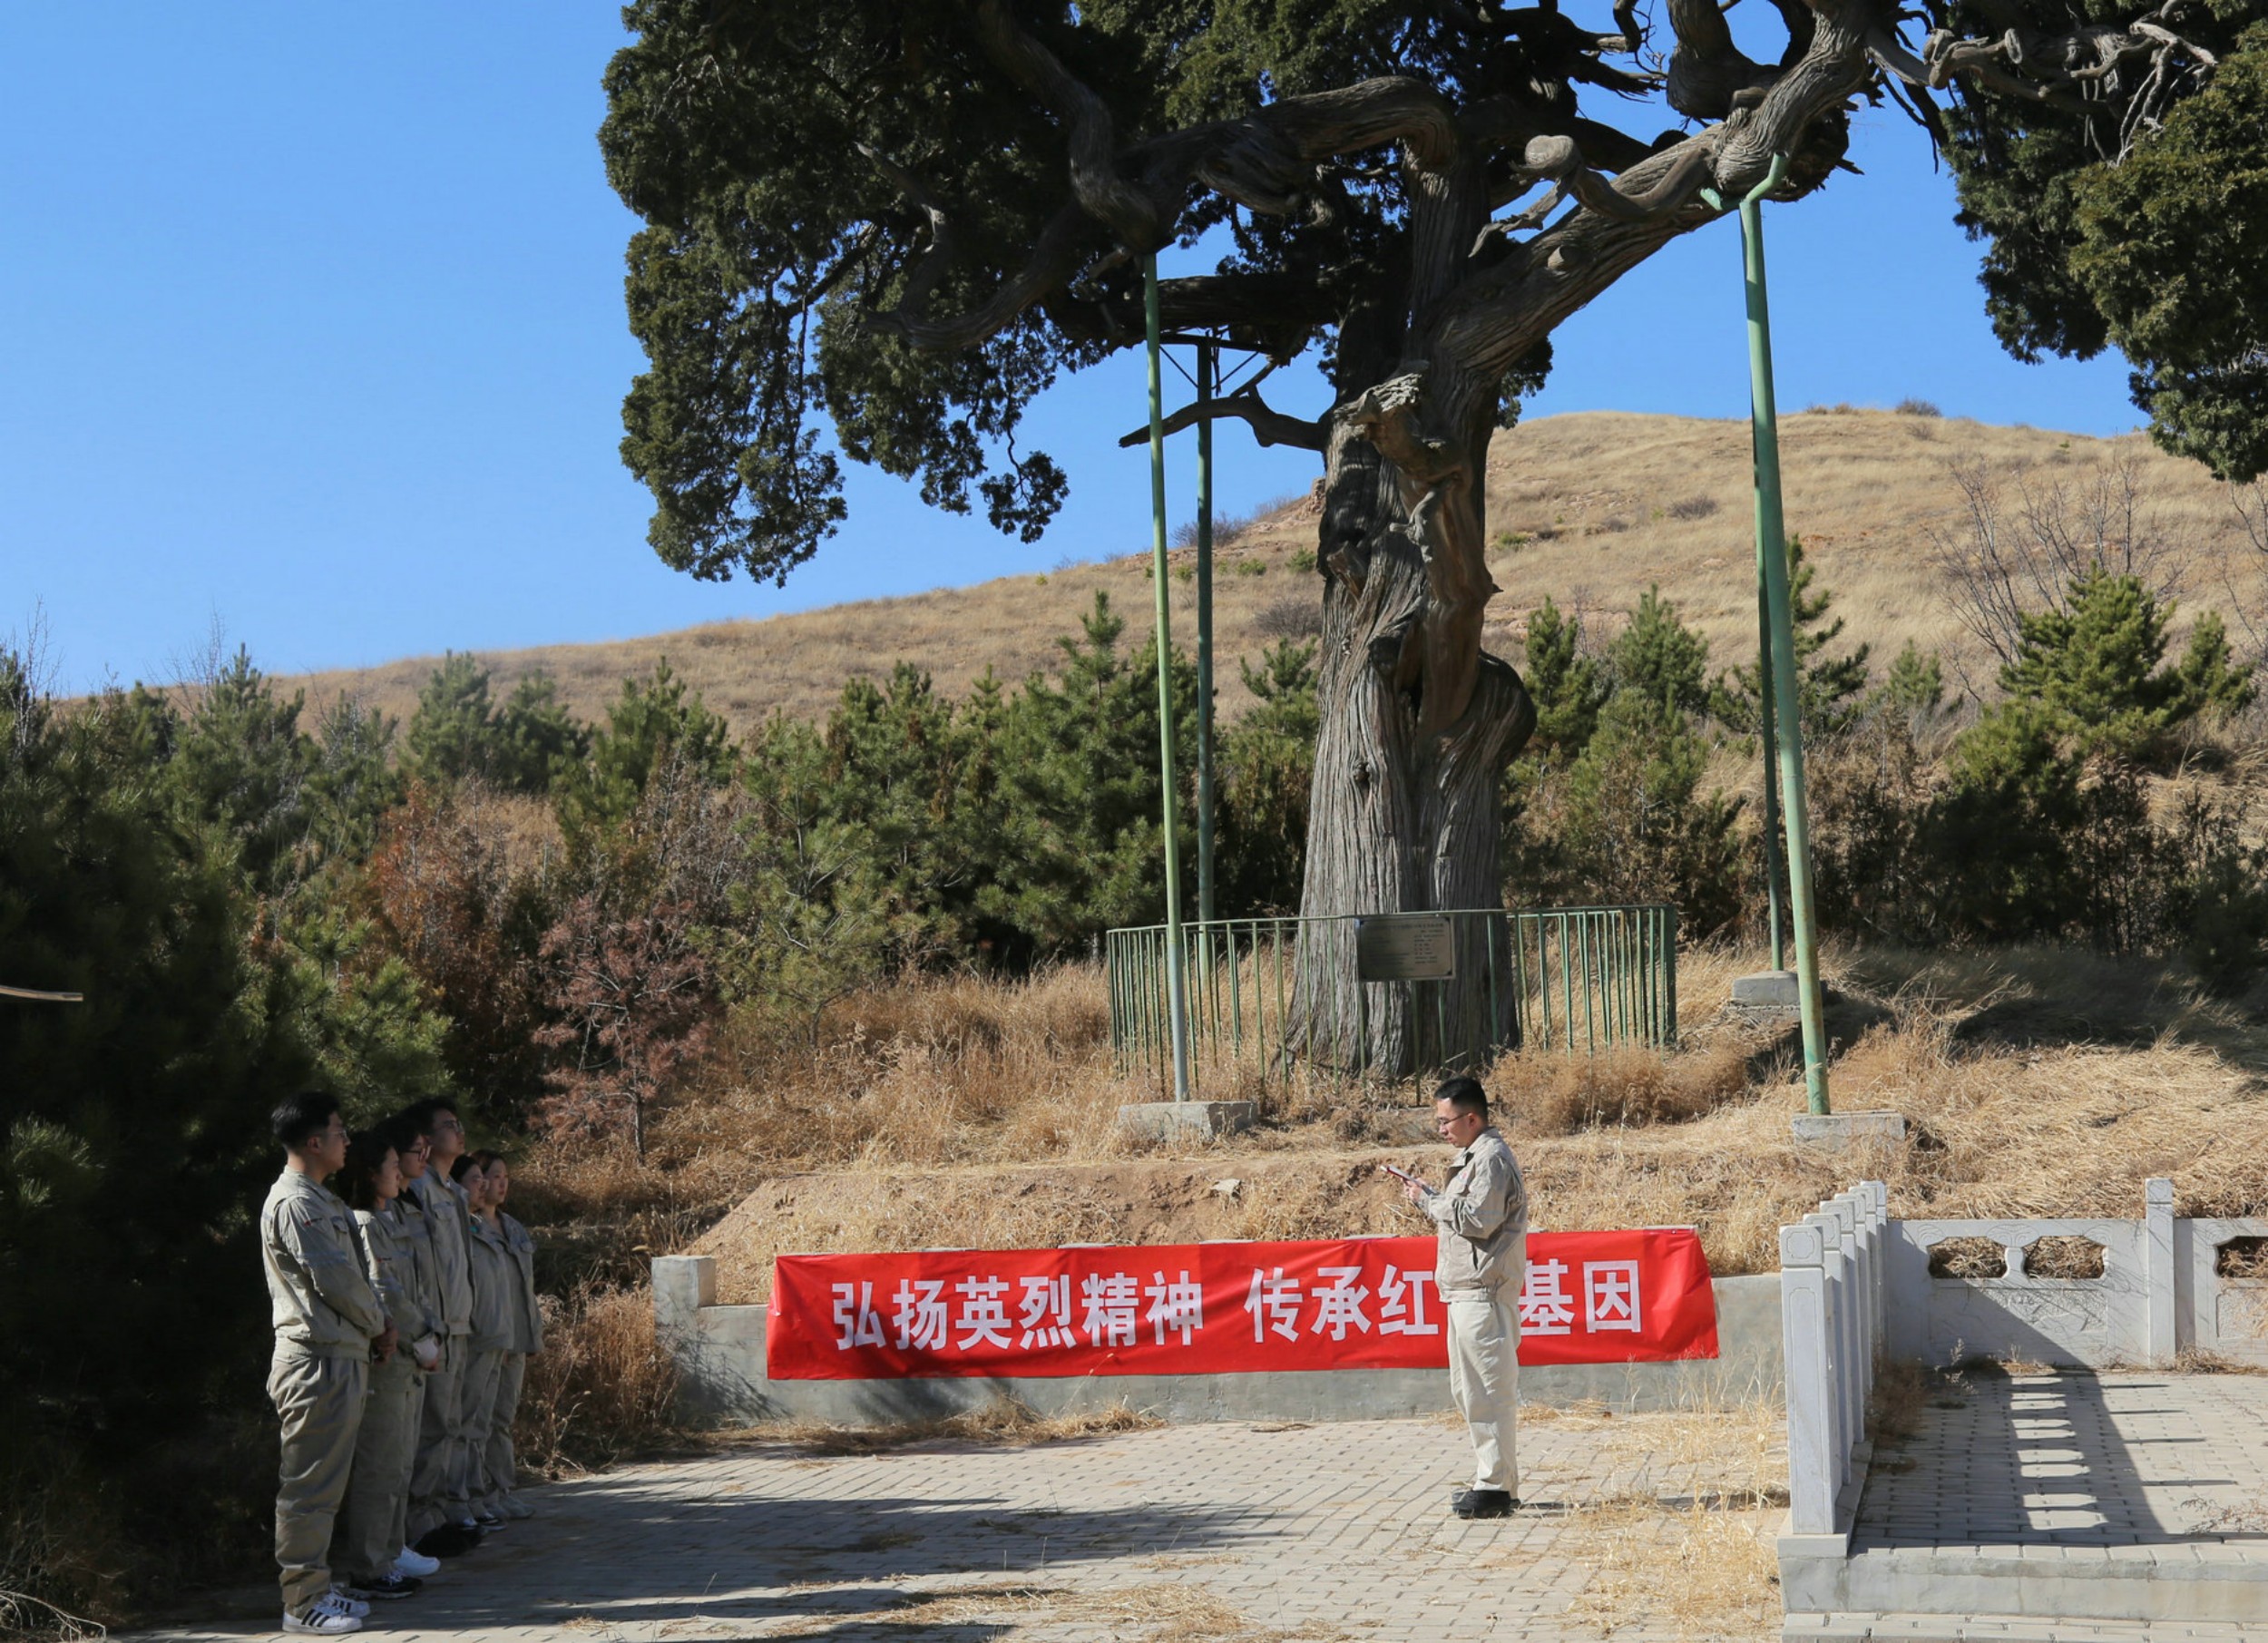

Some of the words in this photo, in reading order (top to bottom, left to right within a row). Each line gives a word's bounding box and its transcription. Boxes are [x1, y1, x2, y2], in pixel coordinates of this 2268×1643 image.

[831, 1269, 1204, 1351] 弘扬英烈精神
[1242, 1258, 1642, 1343] 传承红基因
